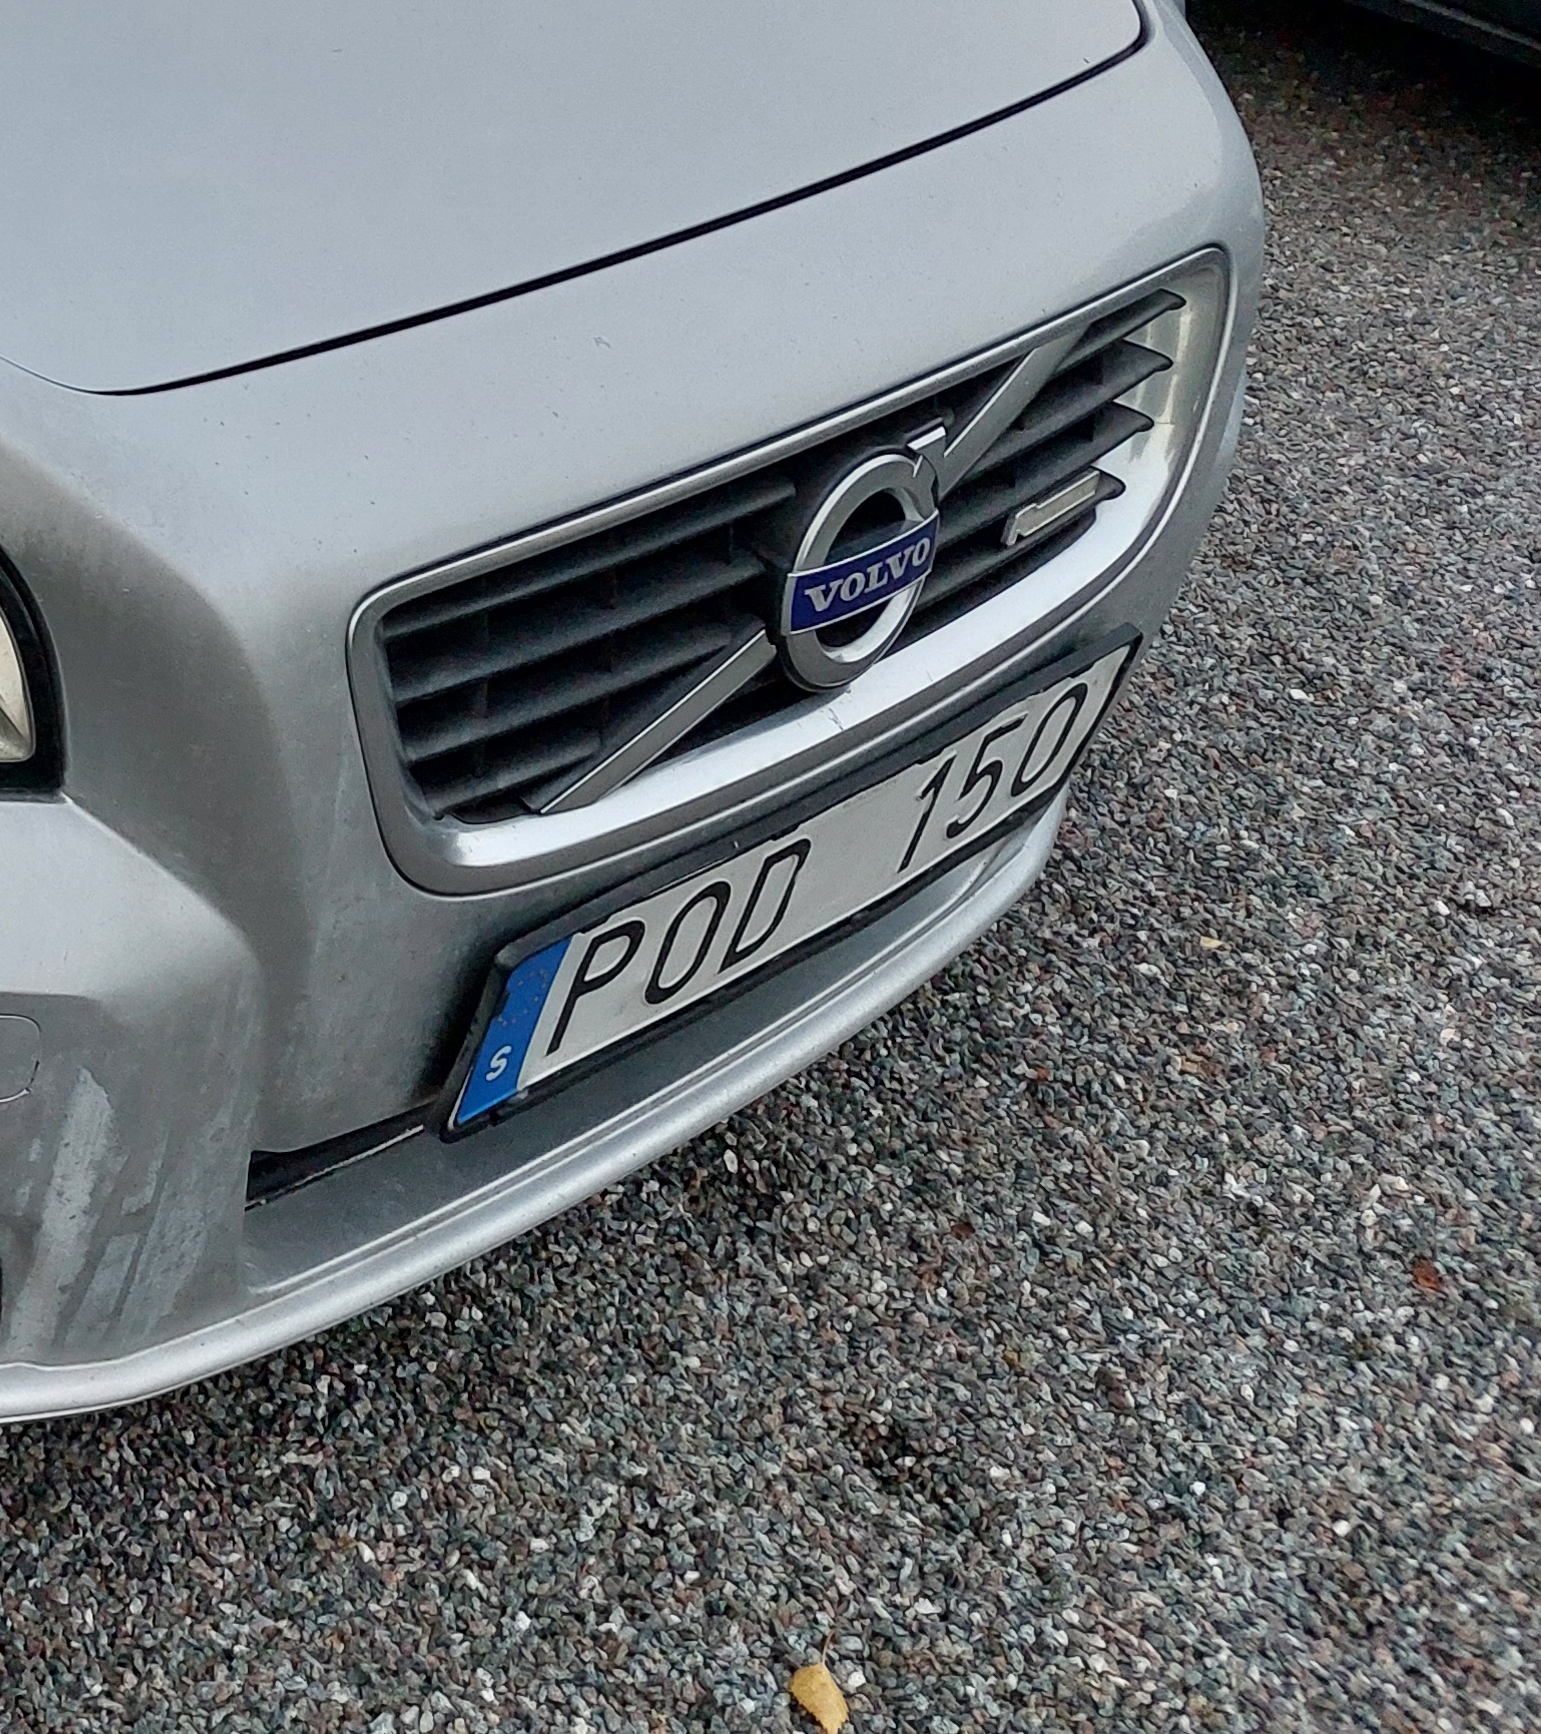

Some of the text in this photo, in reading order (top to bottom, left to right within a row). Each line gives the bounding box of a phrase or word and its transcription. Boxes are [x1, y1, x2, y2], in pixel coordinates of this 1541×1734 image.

[804, 537, 931, 612] VOLVO
[546, 682, 1088, 1057] POD 150
[485, 1045, 512, 1081] S
